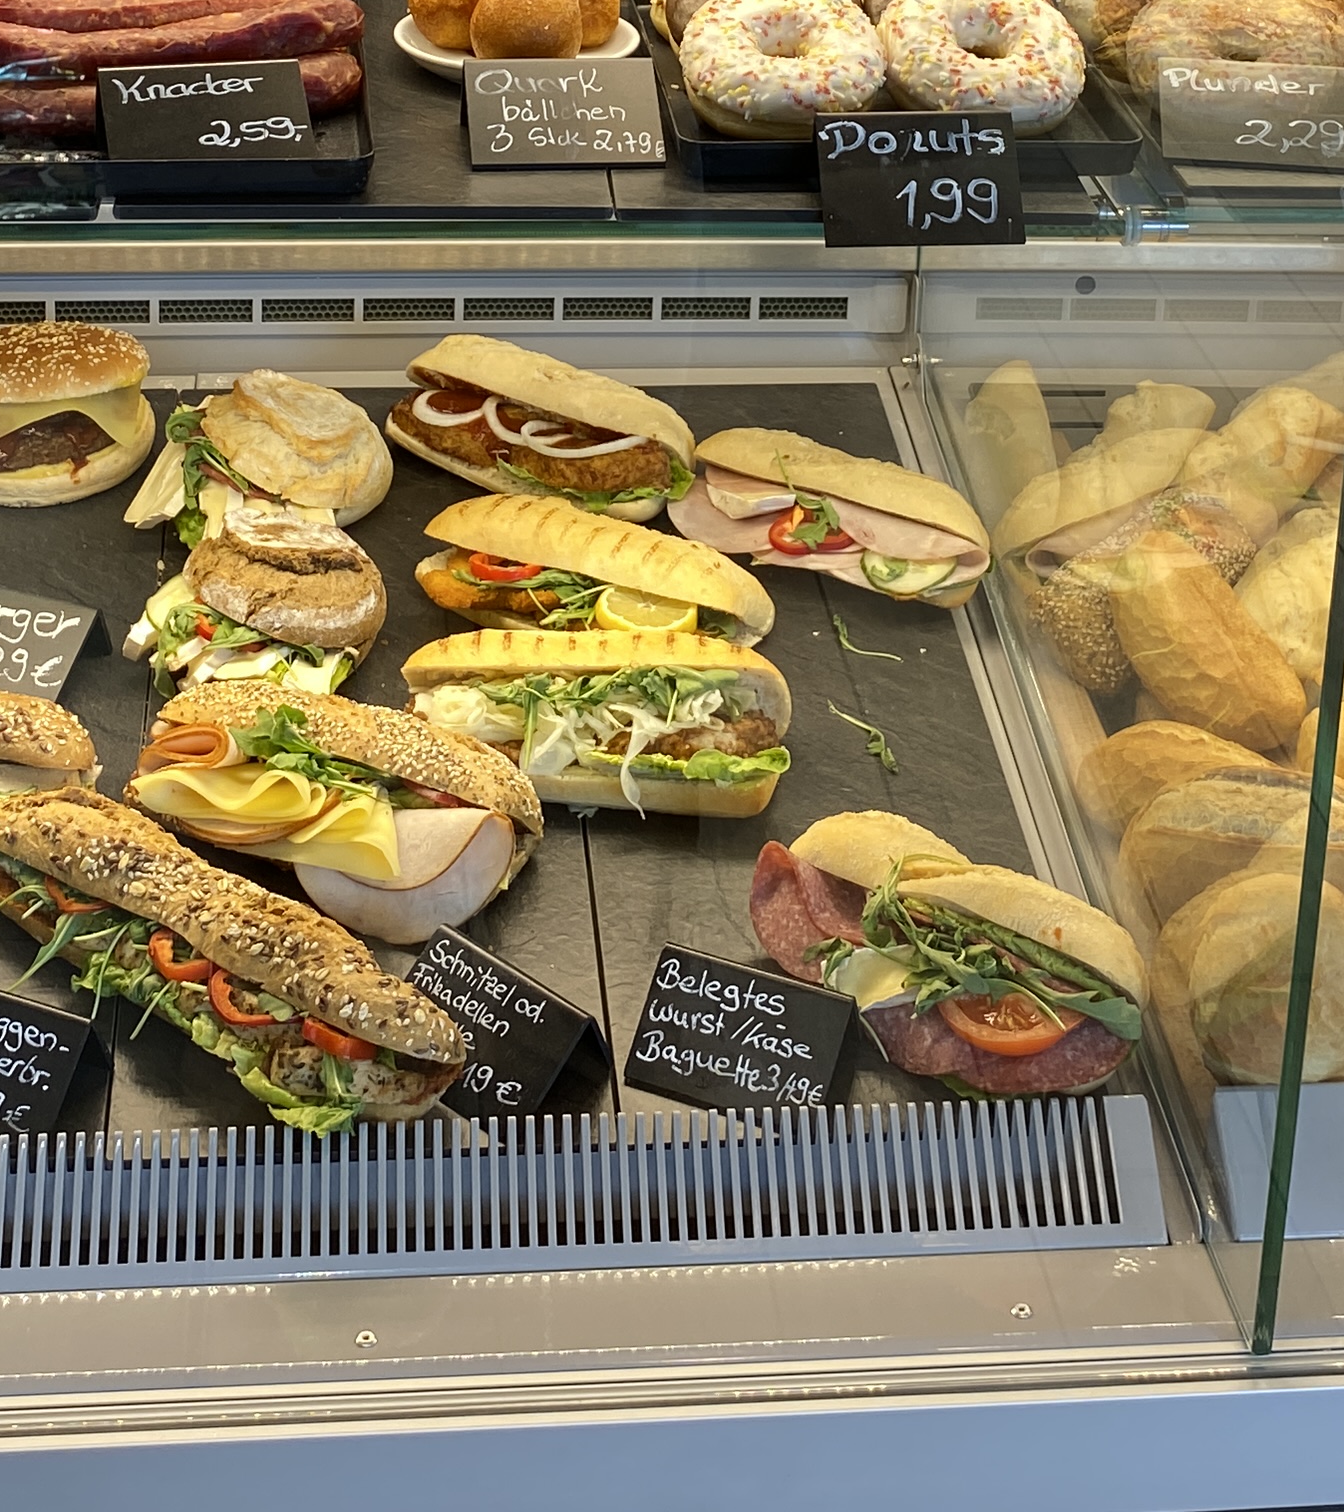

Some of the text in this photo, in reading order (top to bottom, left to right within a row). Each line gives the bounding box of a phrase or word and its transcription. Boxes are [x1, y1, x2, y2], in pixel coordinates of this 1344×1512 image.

[1162, 68, 1325, 96] Plunder
[487, 124, 513, 152] 3
[818, 119, 1006, 159] Donuts
[895, 177, 999, 229] 1,99
[413, 962, 510, 1037] Frikadellen
[429, 939, 547, 1024] Schnitzel od.
[656, 958, 785, 1016] Belegtes
